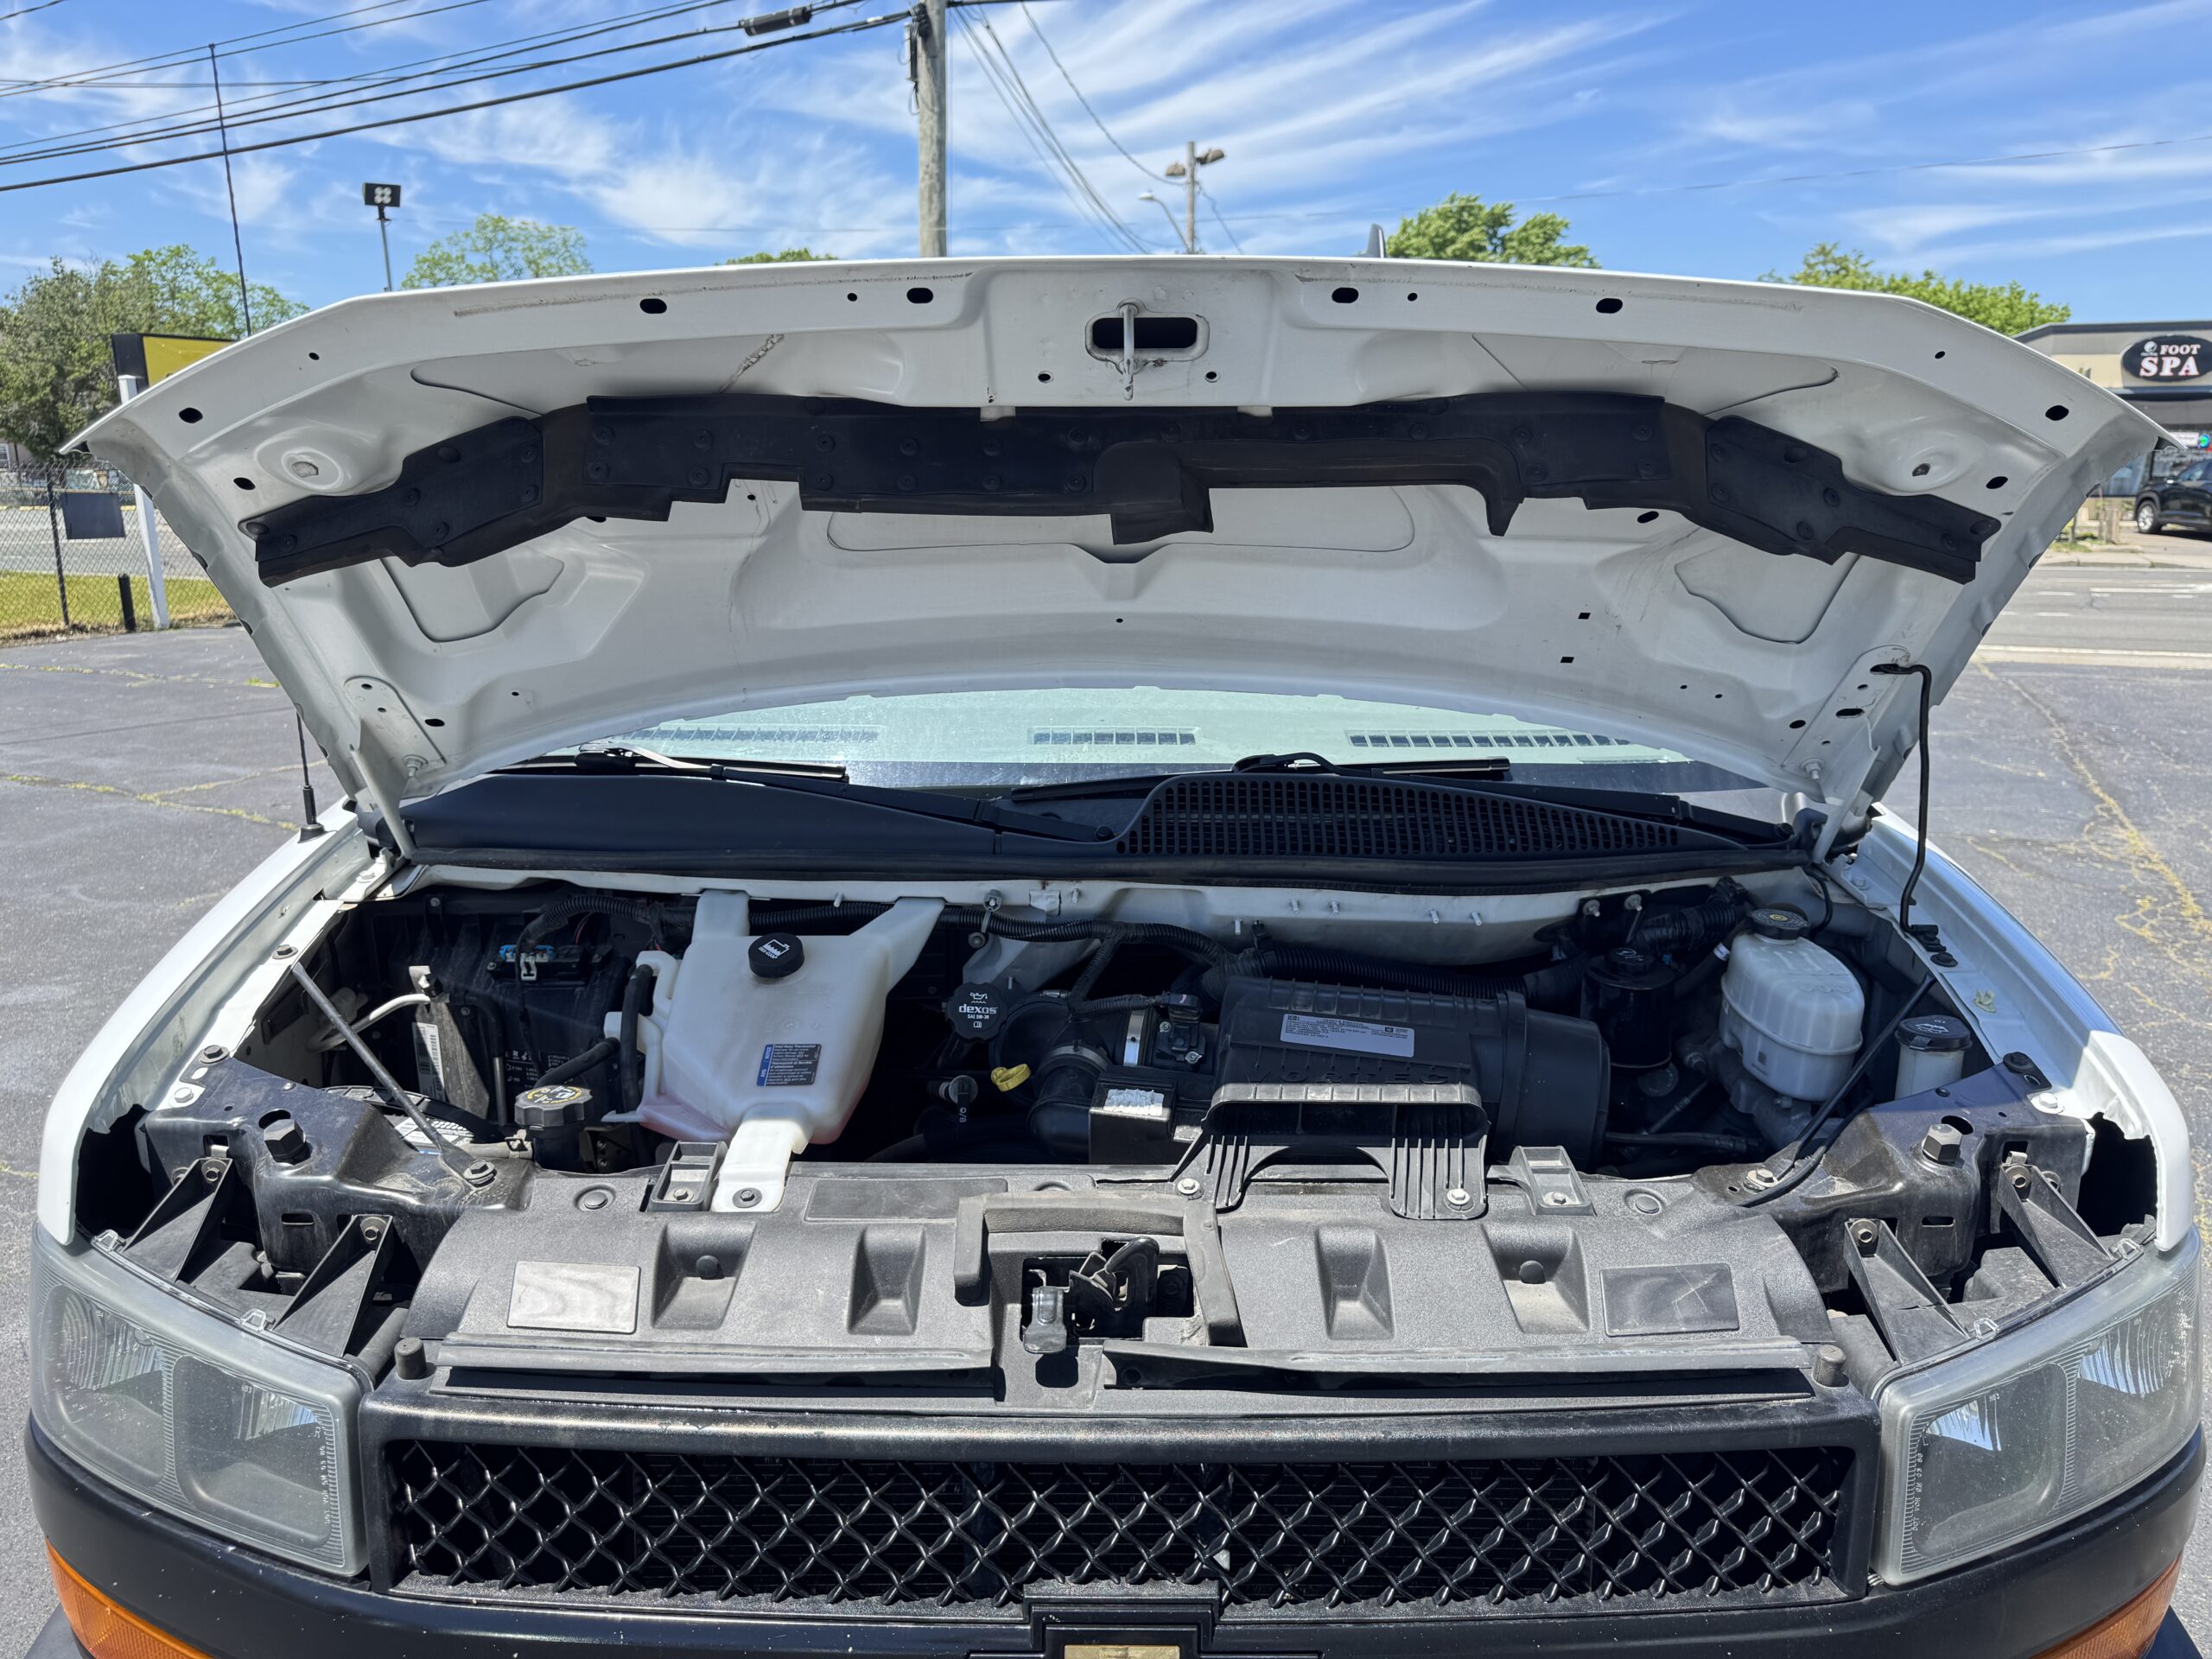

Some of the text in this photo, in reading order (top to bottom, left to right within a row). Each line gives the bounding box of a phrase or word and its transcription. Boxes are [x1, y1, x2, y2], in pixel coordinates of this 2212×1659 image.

[2159, 344, 2202, 355] FOOT
[2139, 356, 2199, 377] SPA
[958, 1003, 998, 1014] dexos
